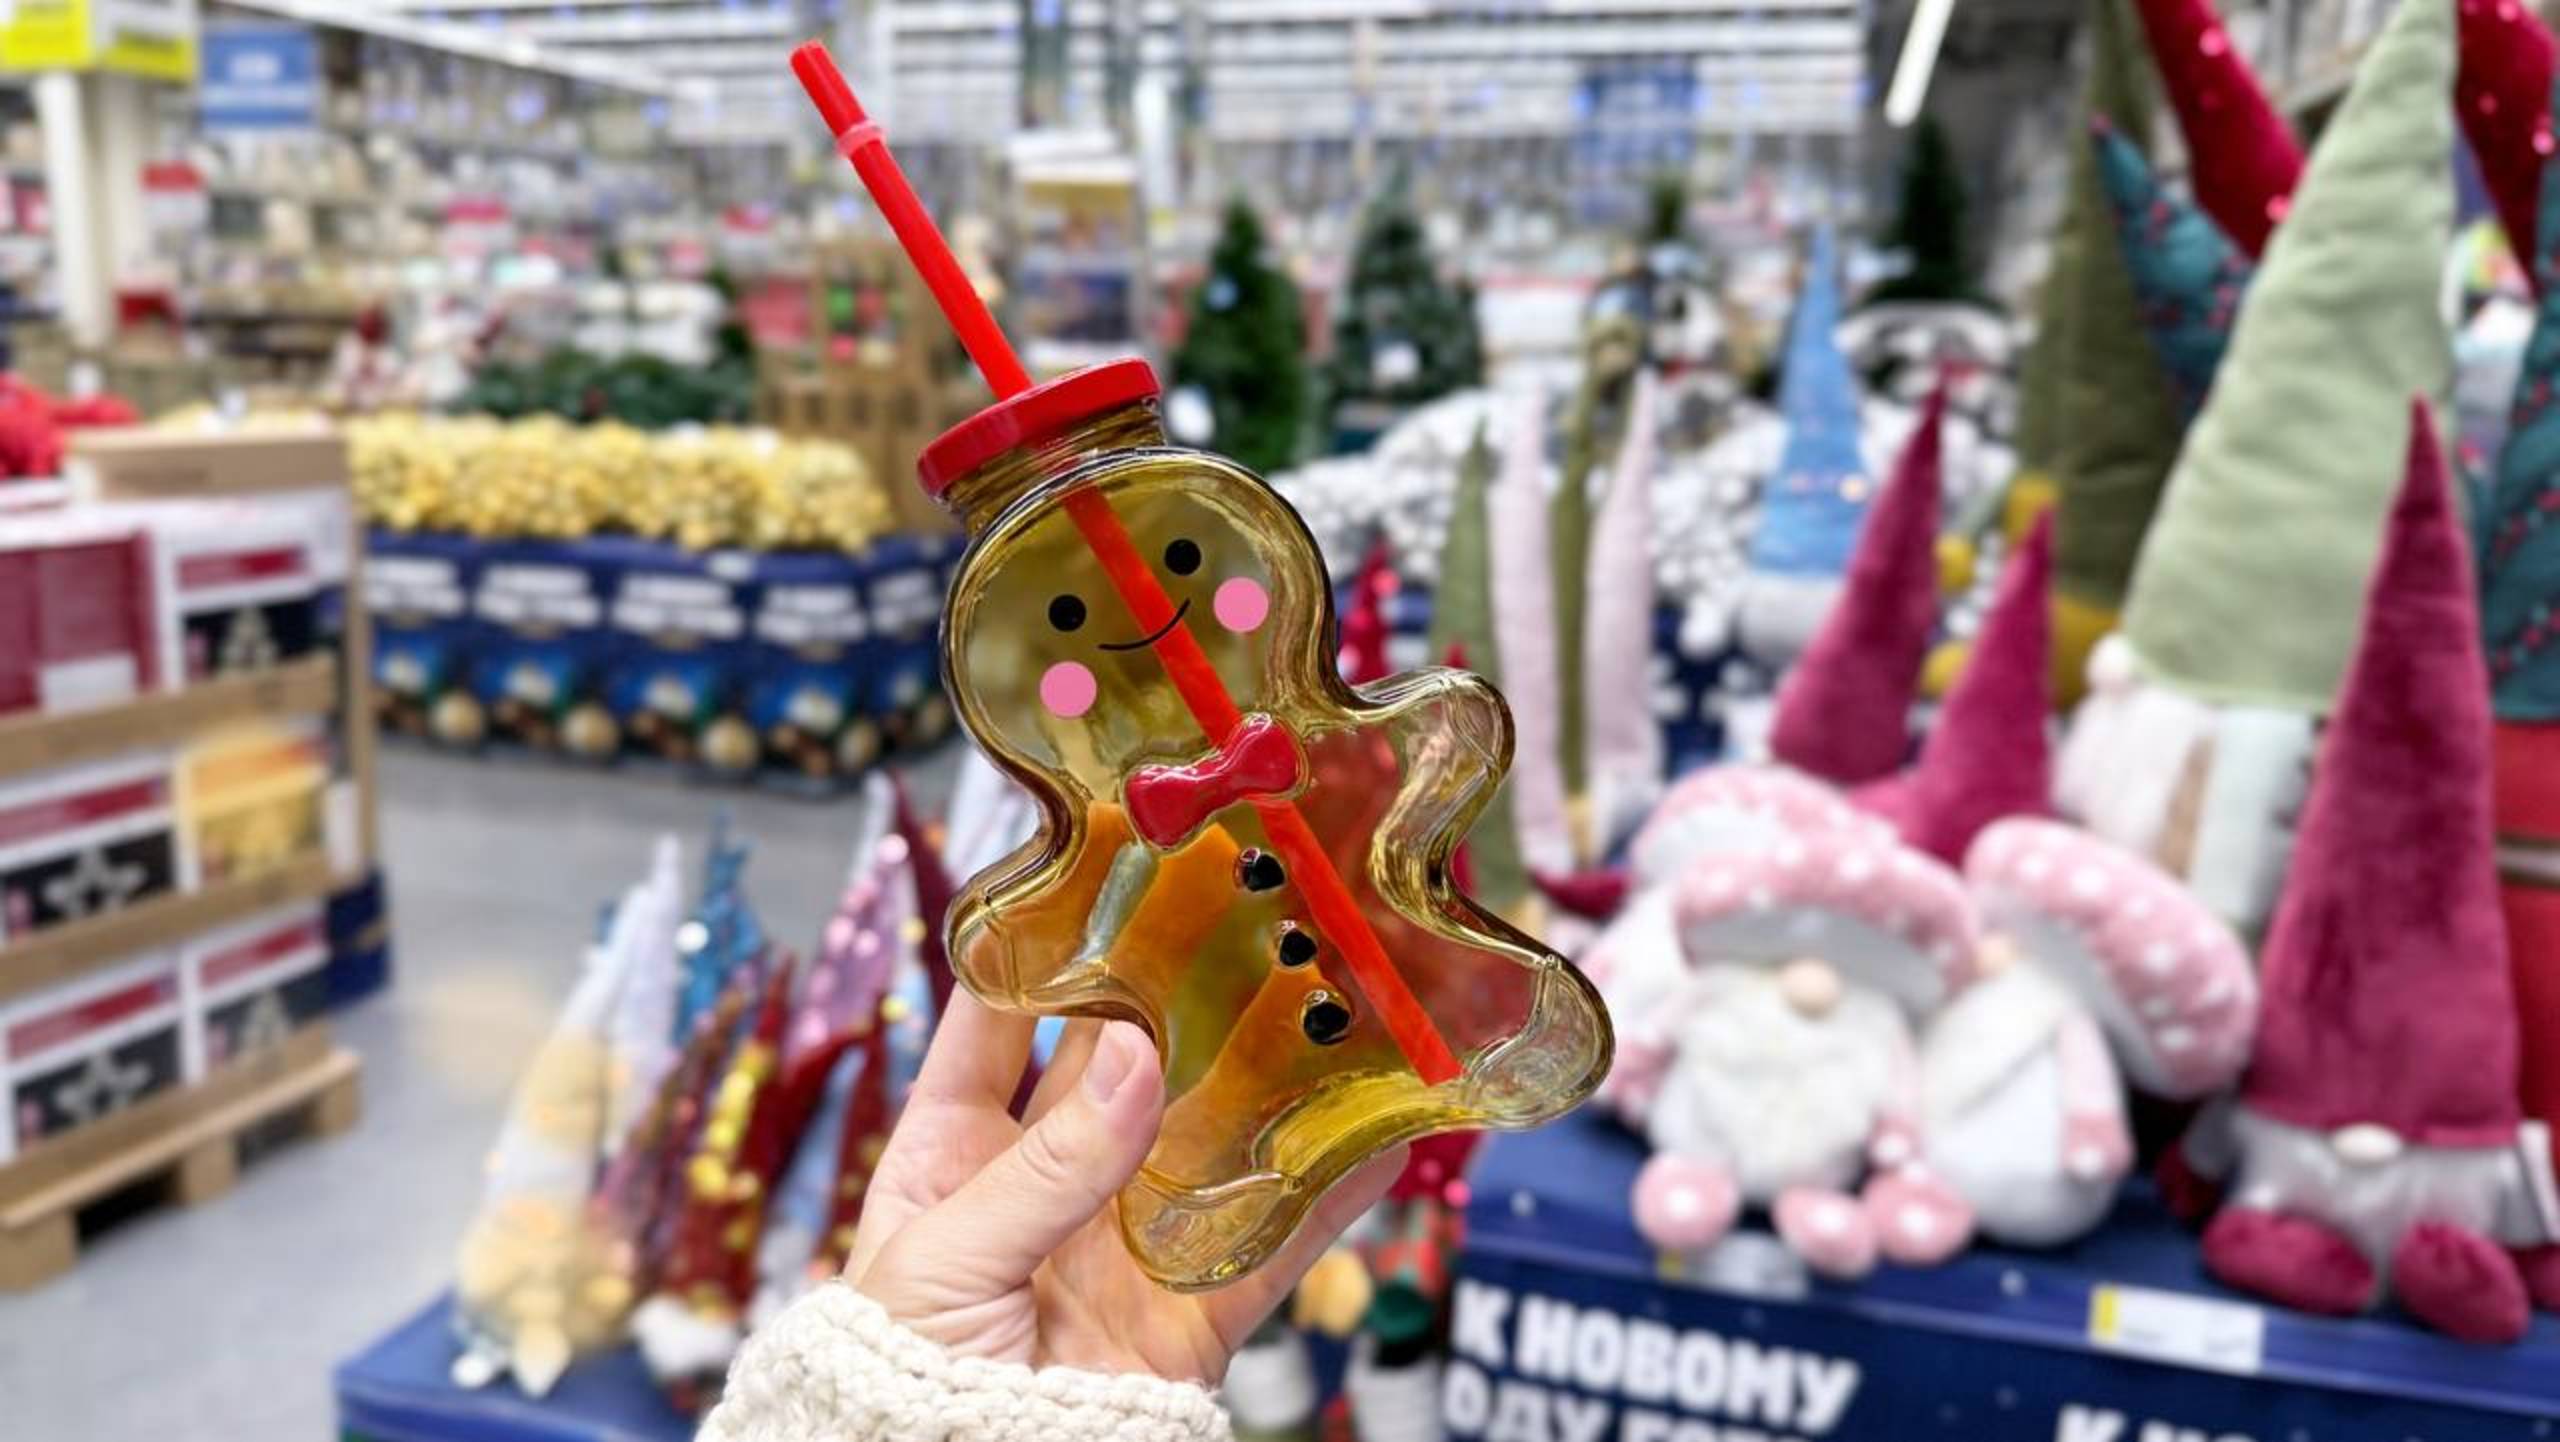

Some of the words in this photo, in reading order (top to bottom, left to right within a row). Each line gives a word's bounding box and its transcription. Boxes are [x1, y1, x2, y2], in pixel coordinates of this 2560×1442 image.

[1443, 1360, 1611, 1442] ОДУ
[1453, 1277, 1510, 1367] К
[1515, 1293, 1861, 1435] НОВОМУ
